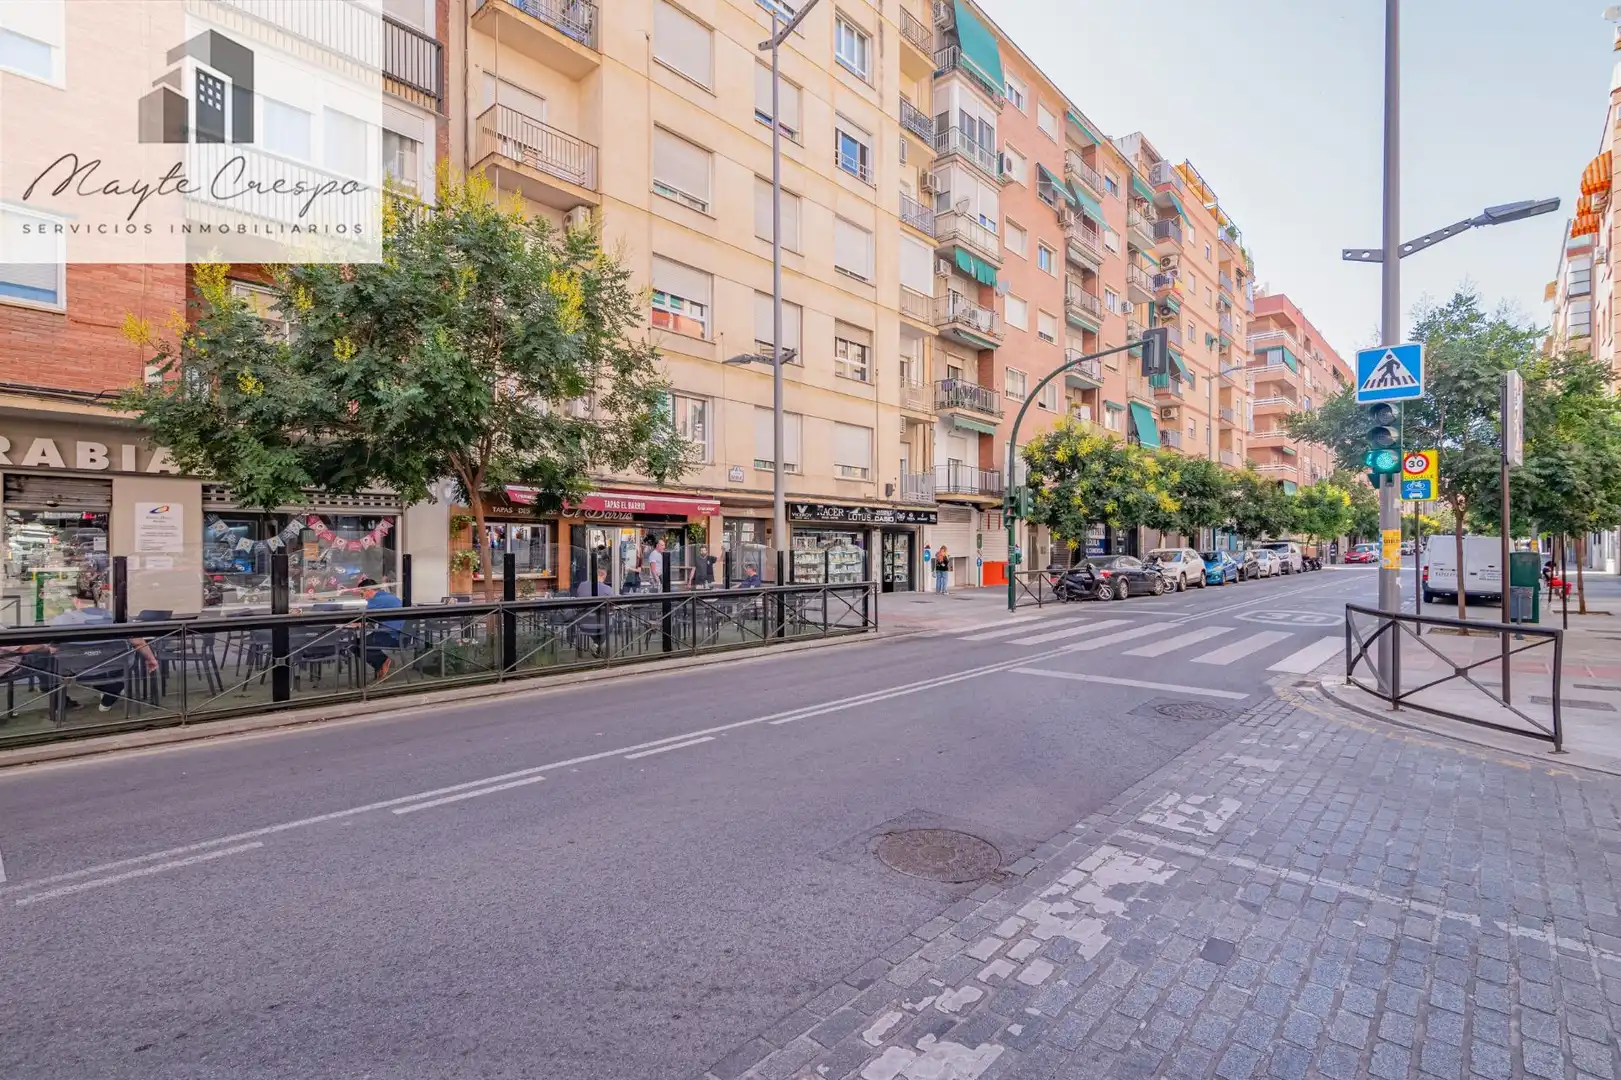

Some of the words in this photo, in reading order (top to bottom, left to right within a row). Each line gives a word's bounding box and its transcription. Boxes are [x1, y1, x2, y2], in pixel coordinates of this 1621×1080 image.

[1408, 460, 1424, 468] 30
[604, 500, 620, 509] TAPAS
[620, 501, 627, 509] EL
[627, 501, 646, 510] BARRIO
[492, 506, 513, 514] TAPAS
[848, 513, 871, 521] LOTUS
